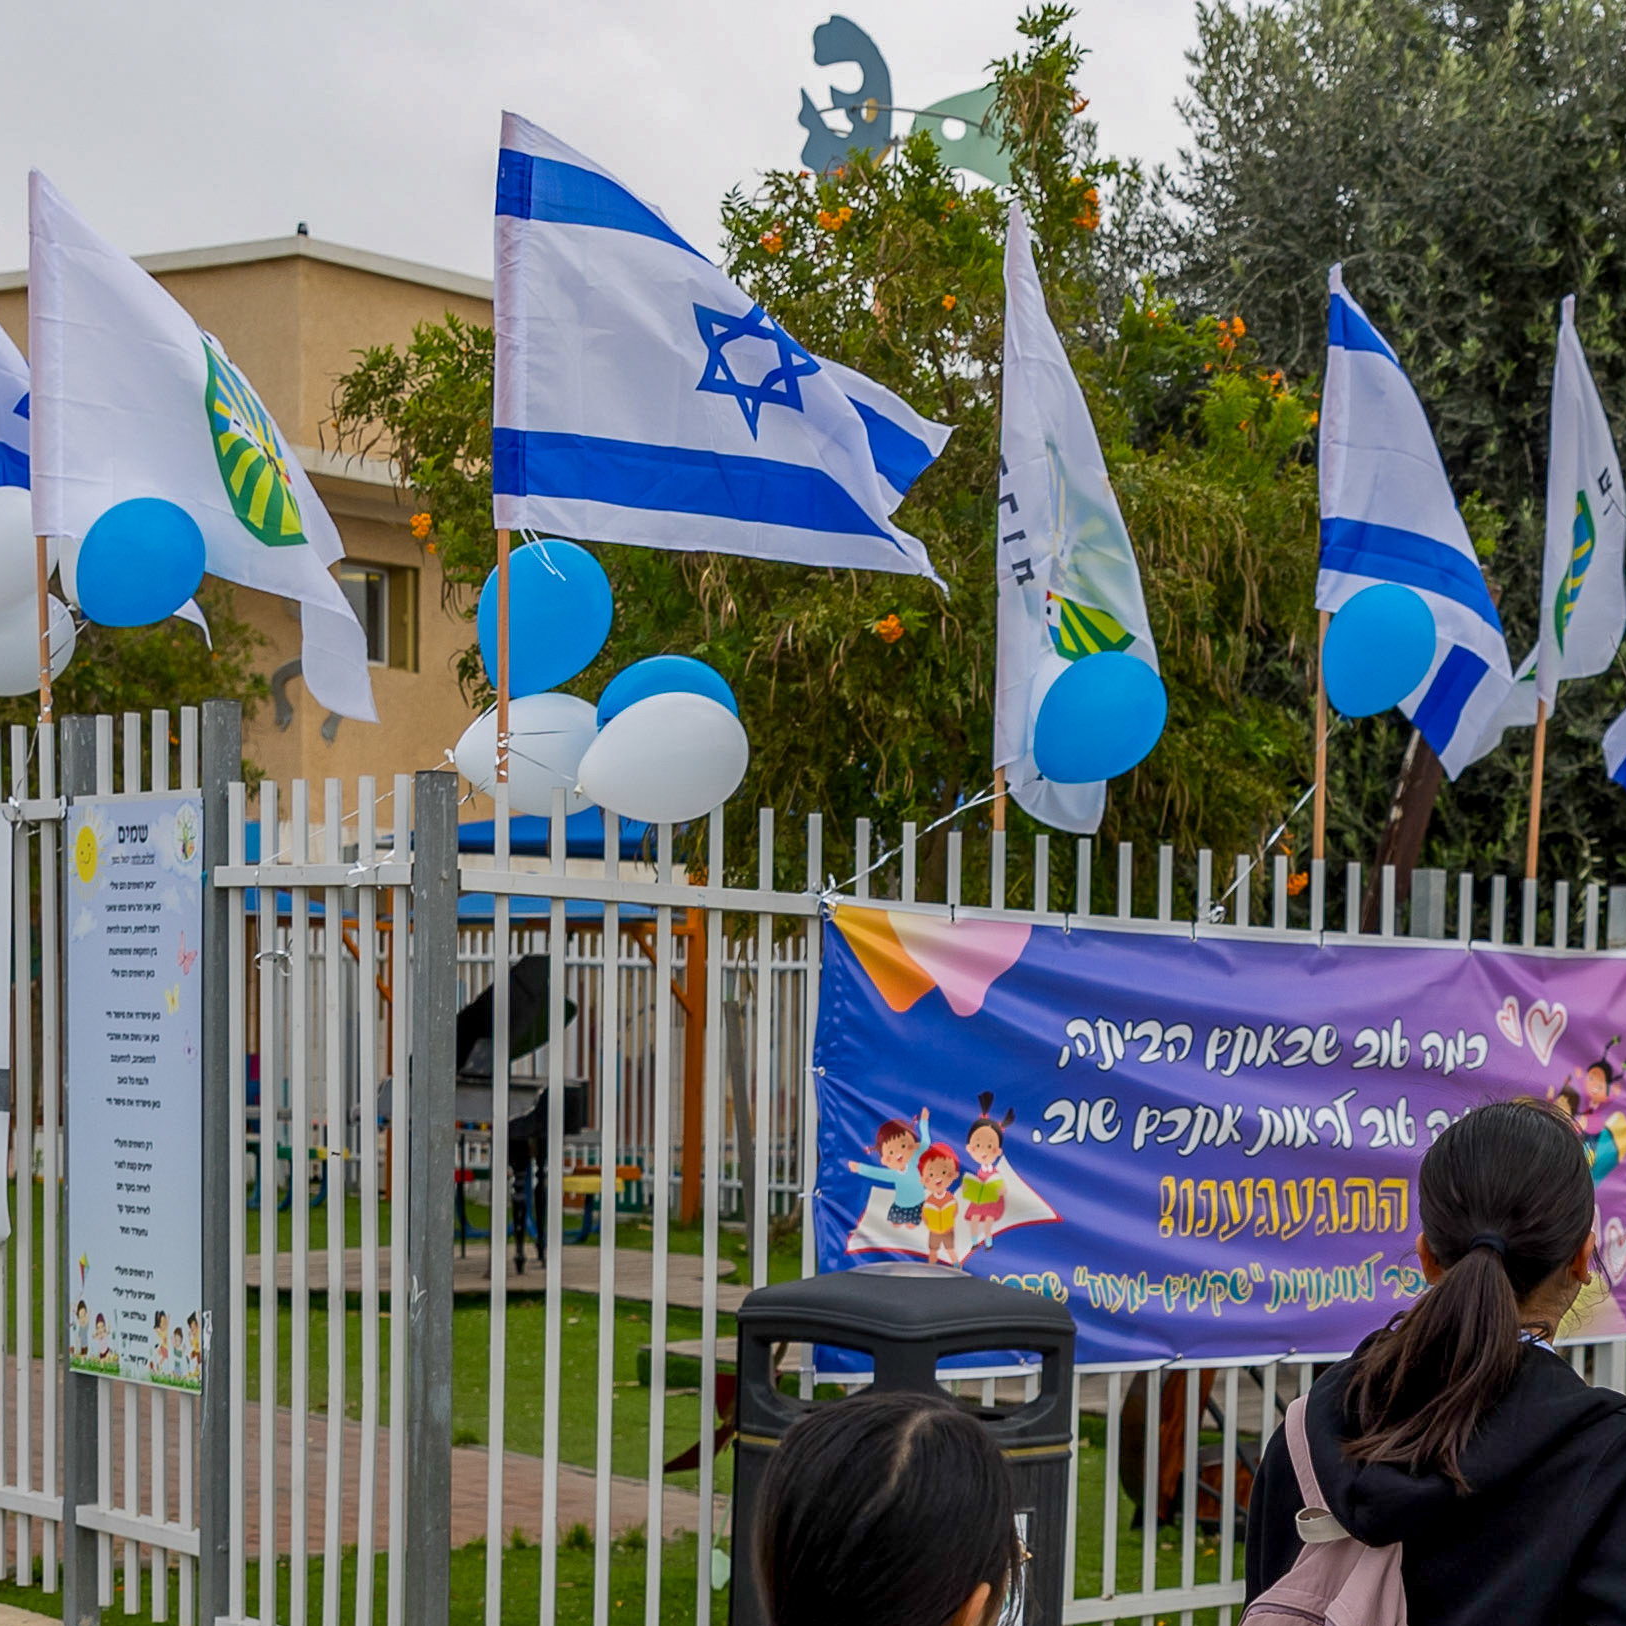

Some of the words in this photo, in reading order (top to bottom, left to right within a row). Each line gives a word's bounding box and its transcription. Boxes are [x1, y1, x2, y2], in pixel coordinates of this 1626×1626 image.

[118, 824, 149, 844] שמים
[1057, 1016, 1194, 1072] הביתה,
[1204, 1023, 1342, 1077] שבאתם
[1351, 1017, 1411, 1071] טוב
[1420, 1029, 1489, 1076] כמה
[1031, 1097, 1122, 1145] שוב.
[1132, 1102, 1243, 1156] אתכם
[1243, 1089, 1358, 1157] לראות
[1358, 1096, 1416, 1148] טוב
[1158, 1175, 1410, 1242] התגעגענו!
[1074, 1262, 1265, 1317] "שקמים-מעוז"
[1264, 1250, 1384, 1313] לאומנויות
